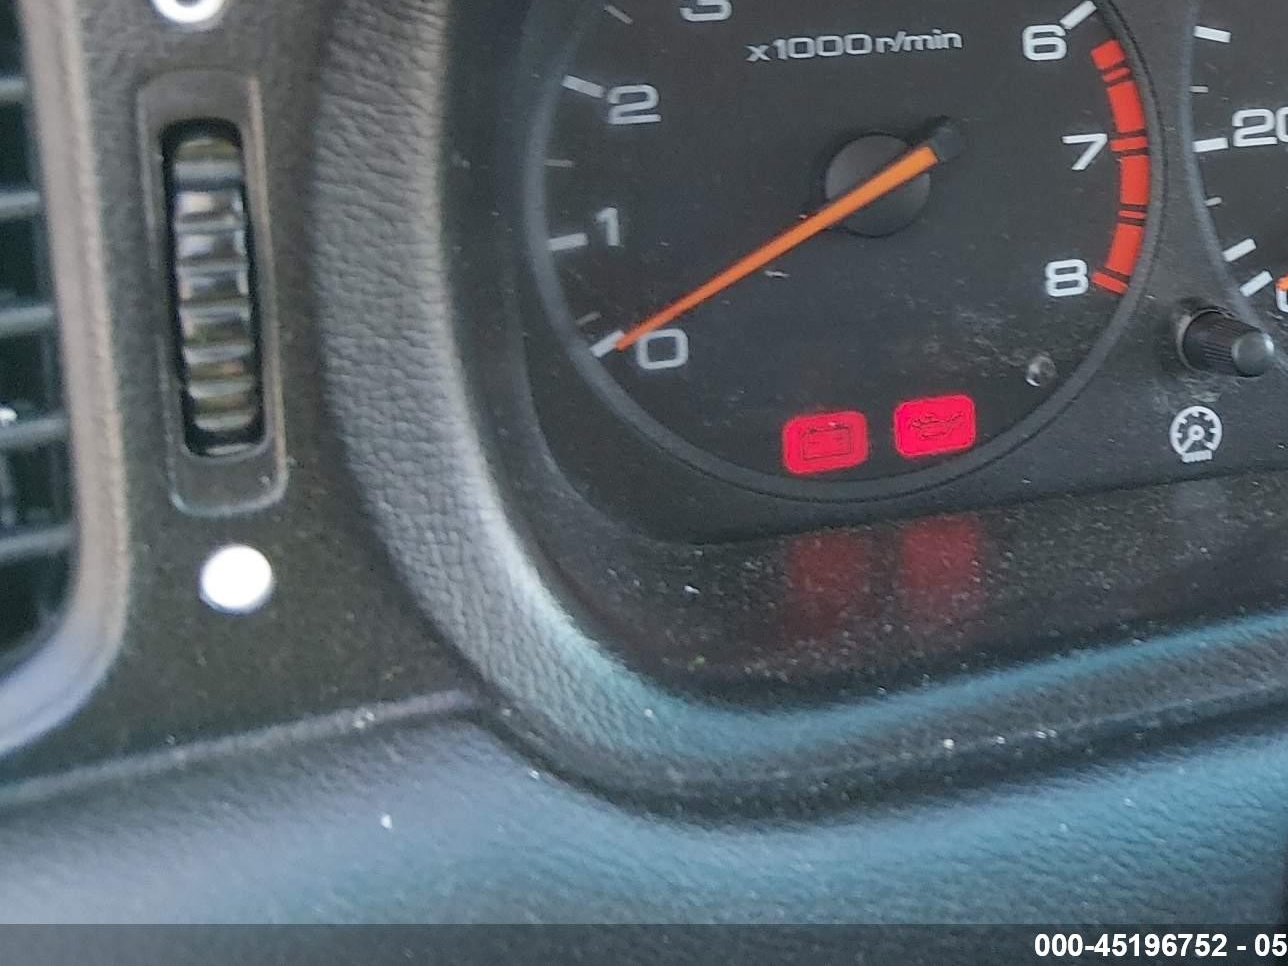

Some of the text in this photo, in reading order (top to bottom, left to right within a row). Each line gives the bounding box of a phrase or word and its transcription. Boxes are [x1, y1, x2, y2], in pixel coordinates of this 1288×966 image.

[746, 29, 963, 62] x1000 r/min
[1022, 24, 1067, 60] 6
[606, 84, 661, 125] 2
[1062, 132, 1108, 171] 7
[596, 207, 621, 247] 1
[1045, 259, 1089, 297] 8
[636, 328, 689, 370] 0
